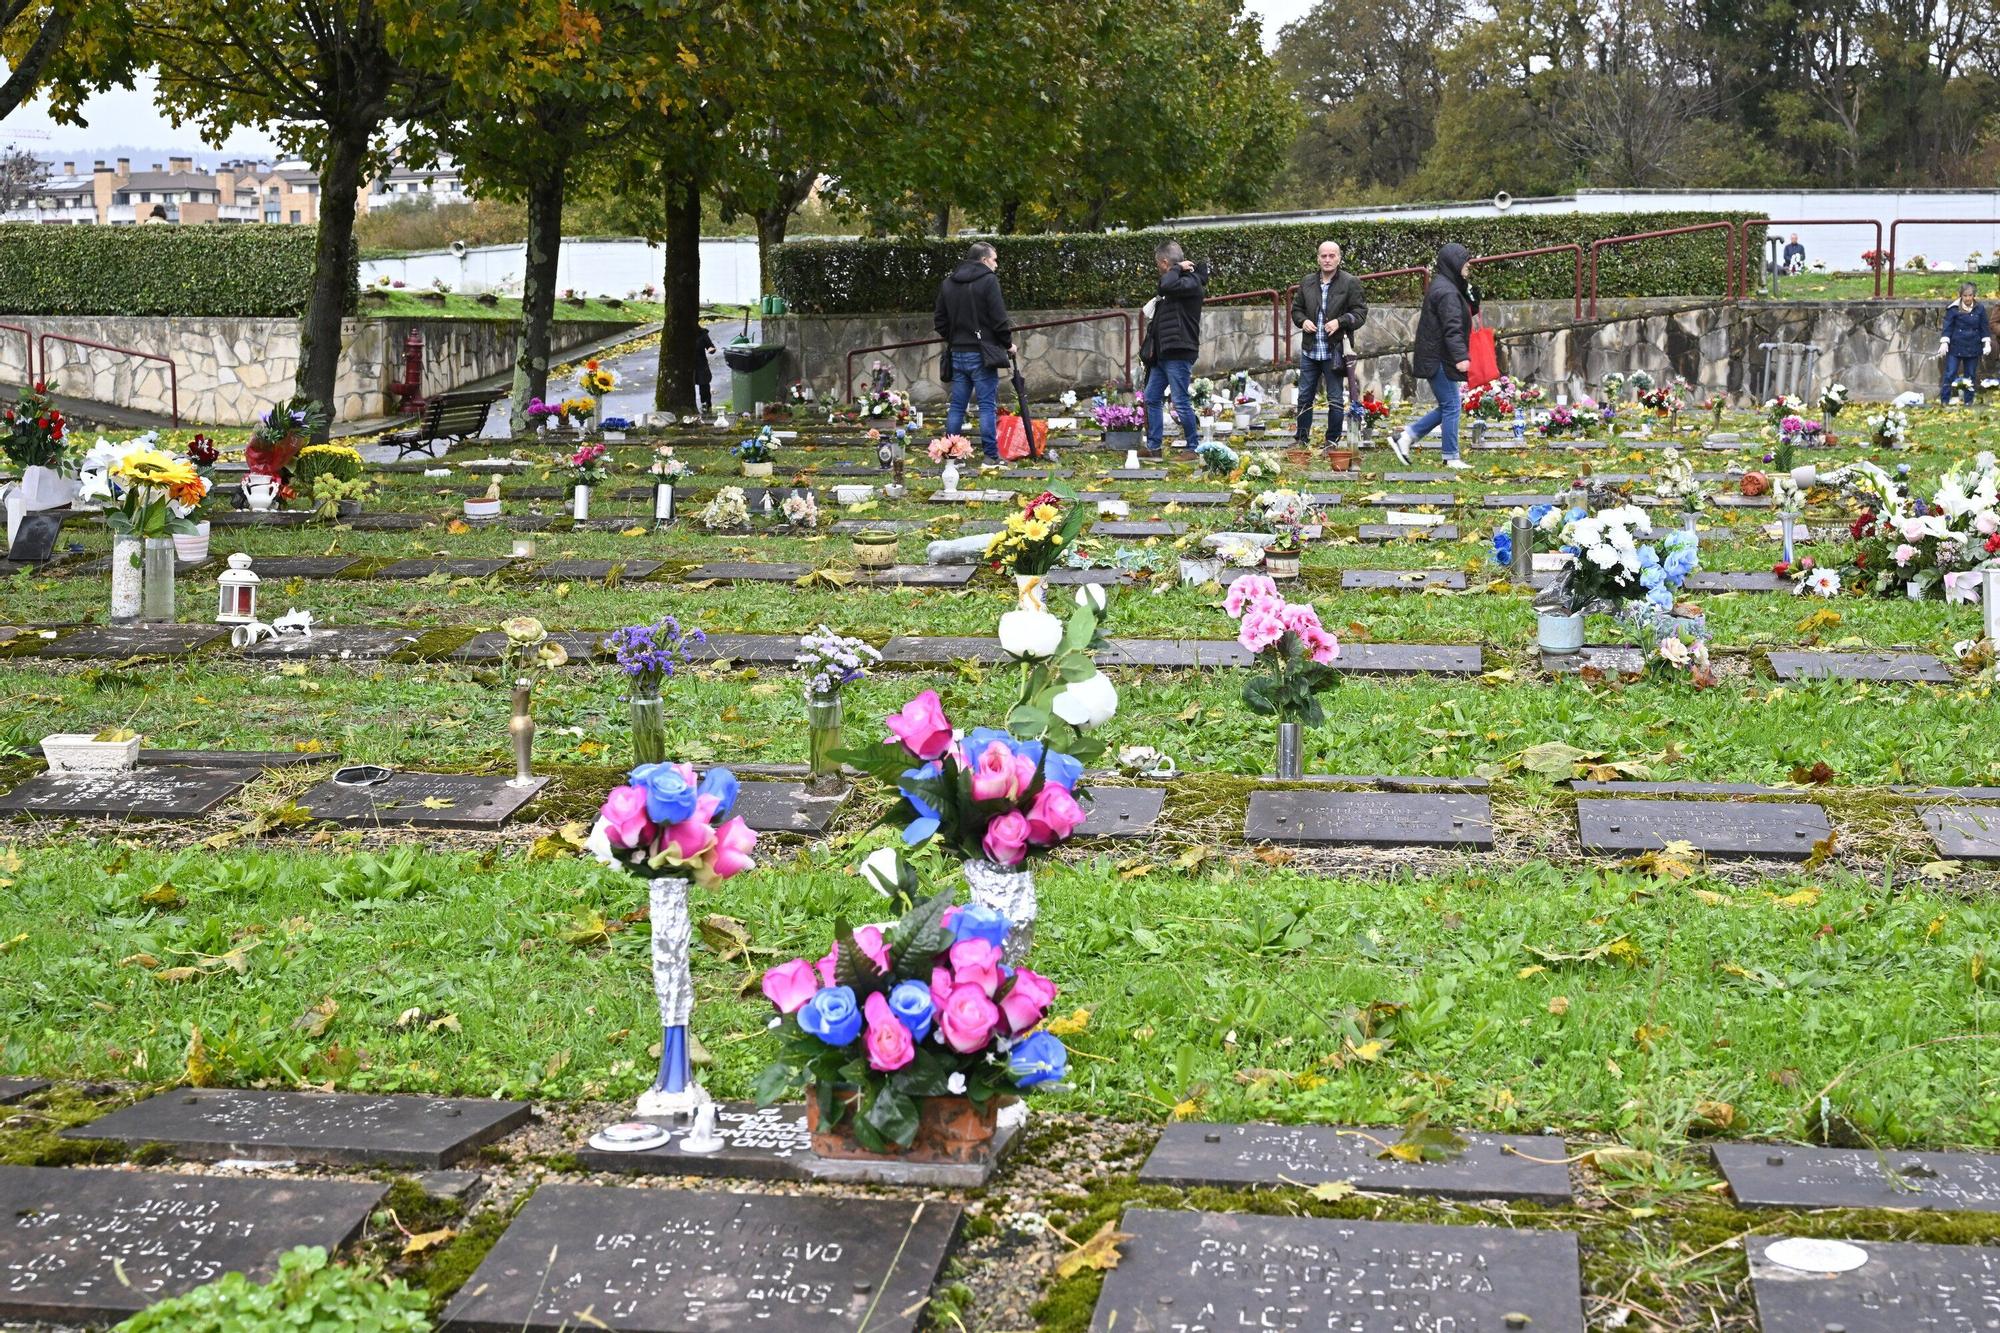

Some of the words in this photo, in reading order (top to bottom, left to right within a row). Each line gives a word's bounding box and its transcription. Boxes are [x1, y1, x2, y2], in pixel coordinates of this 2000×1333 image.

[1190, 1258, 1366, 1288] MENENDEZ
[1385, 1271, 1495, 1296] LANZA
[1195, 1302, 1215, 1322] A
[1238, 1304, 1304, 1328] LOS
